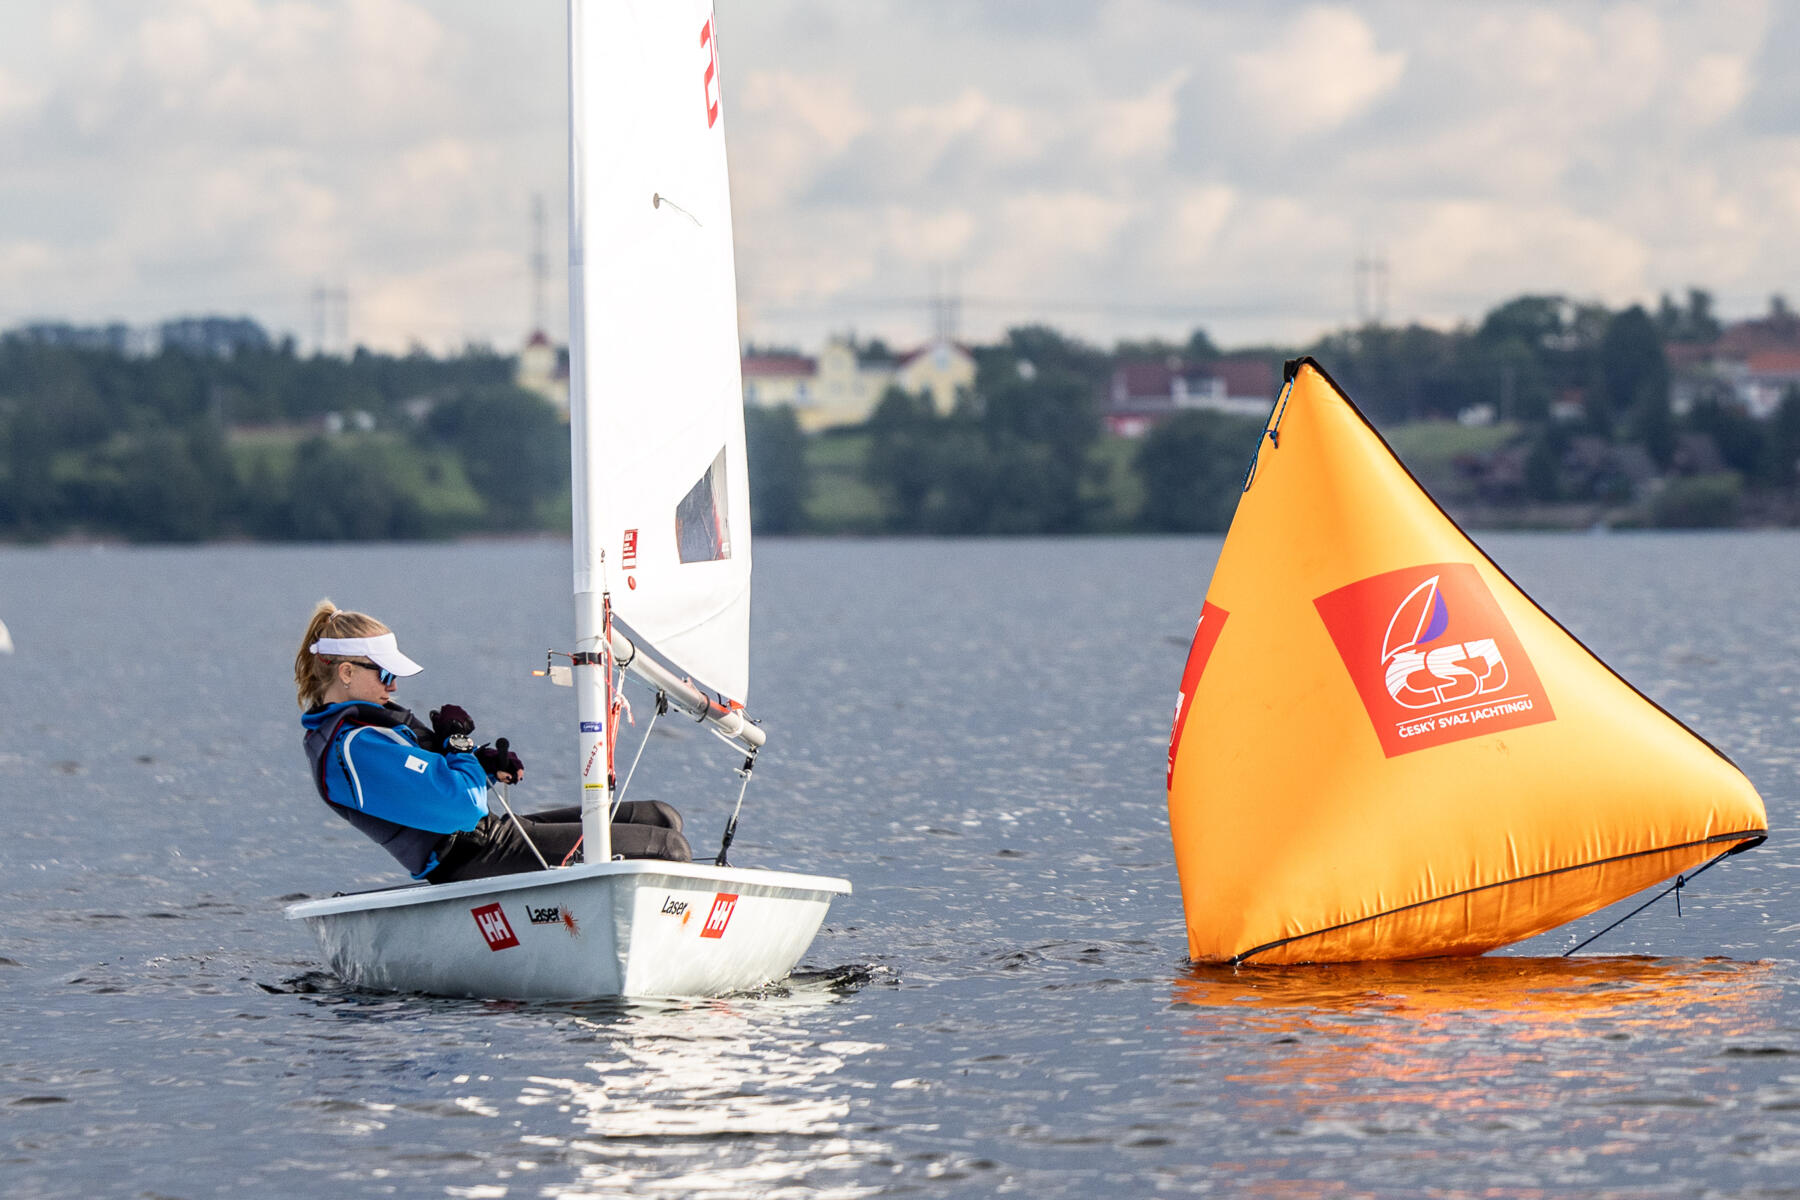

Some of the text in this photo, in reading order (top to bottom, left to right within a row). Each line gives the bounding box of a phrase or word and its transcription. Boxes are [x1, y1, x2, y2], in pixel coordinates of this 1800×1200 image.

[1398, 700, 1533, 738] ČESKÝ SVAZ JACHTINGU
[525, 905, 560, 922] Laser
[661, 896, 688, 915] Laser
